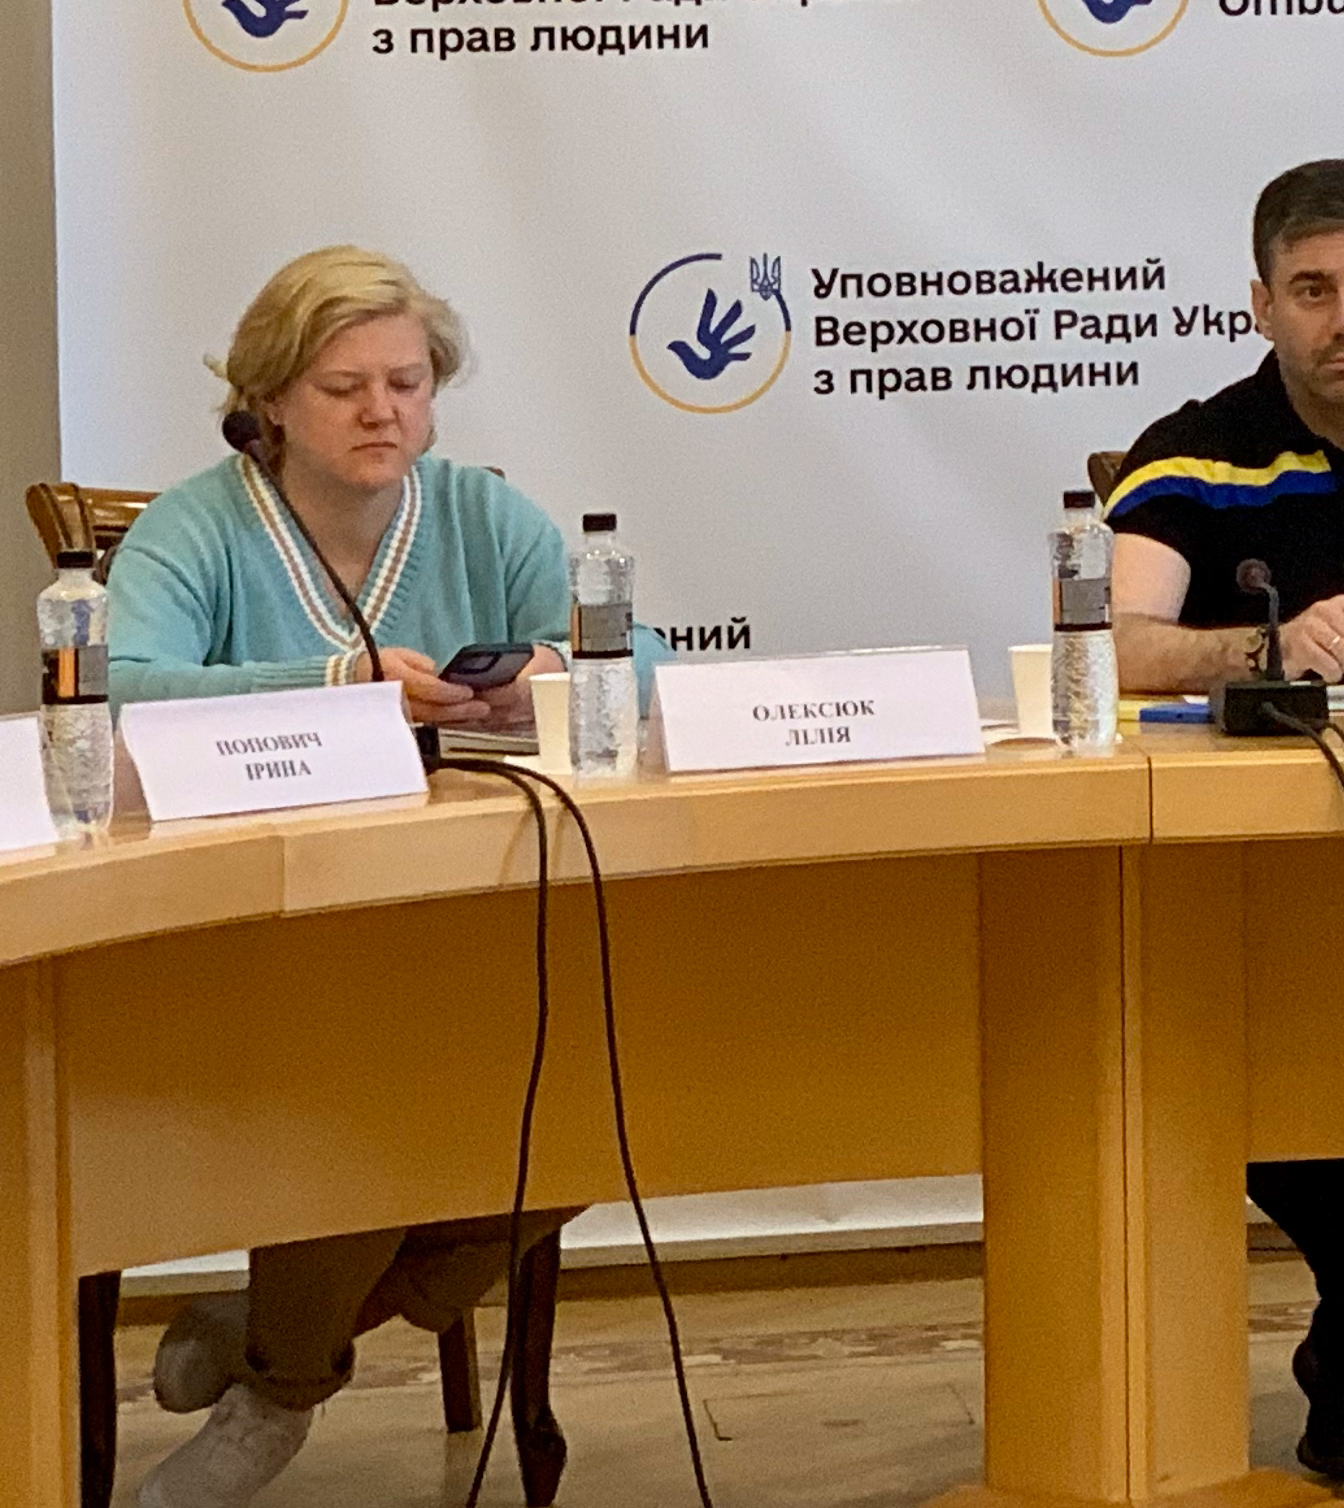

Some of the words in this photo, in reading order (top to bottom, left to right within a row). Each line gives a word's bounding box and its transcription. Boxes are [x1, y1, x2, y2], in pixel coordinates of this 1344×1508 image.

[372, 28, 394, 54] з
[410, 27, 516, 61] прав
[530, 24, 709, 56] людини
[811, 257, 1165, 300] Уповноважений
[815, 308, 1040, 353] Верховної
[1054, 309, 1158, 345] Ради
[813, 369, 835, 395] з
[850, 366, 953, 401] прав
[966, 361, 1139, 394] людини
[752, 699, 875, 722] ОЛЕКСЮК
[215, 732, 323, 756] ПОПОВИЧ
[785, 726, 851, 747] ЛІЛІЯ
[244, 760, 312, 781] ІРИНА
